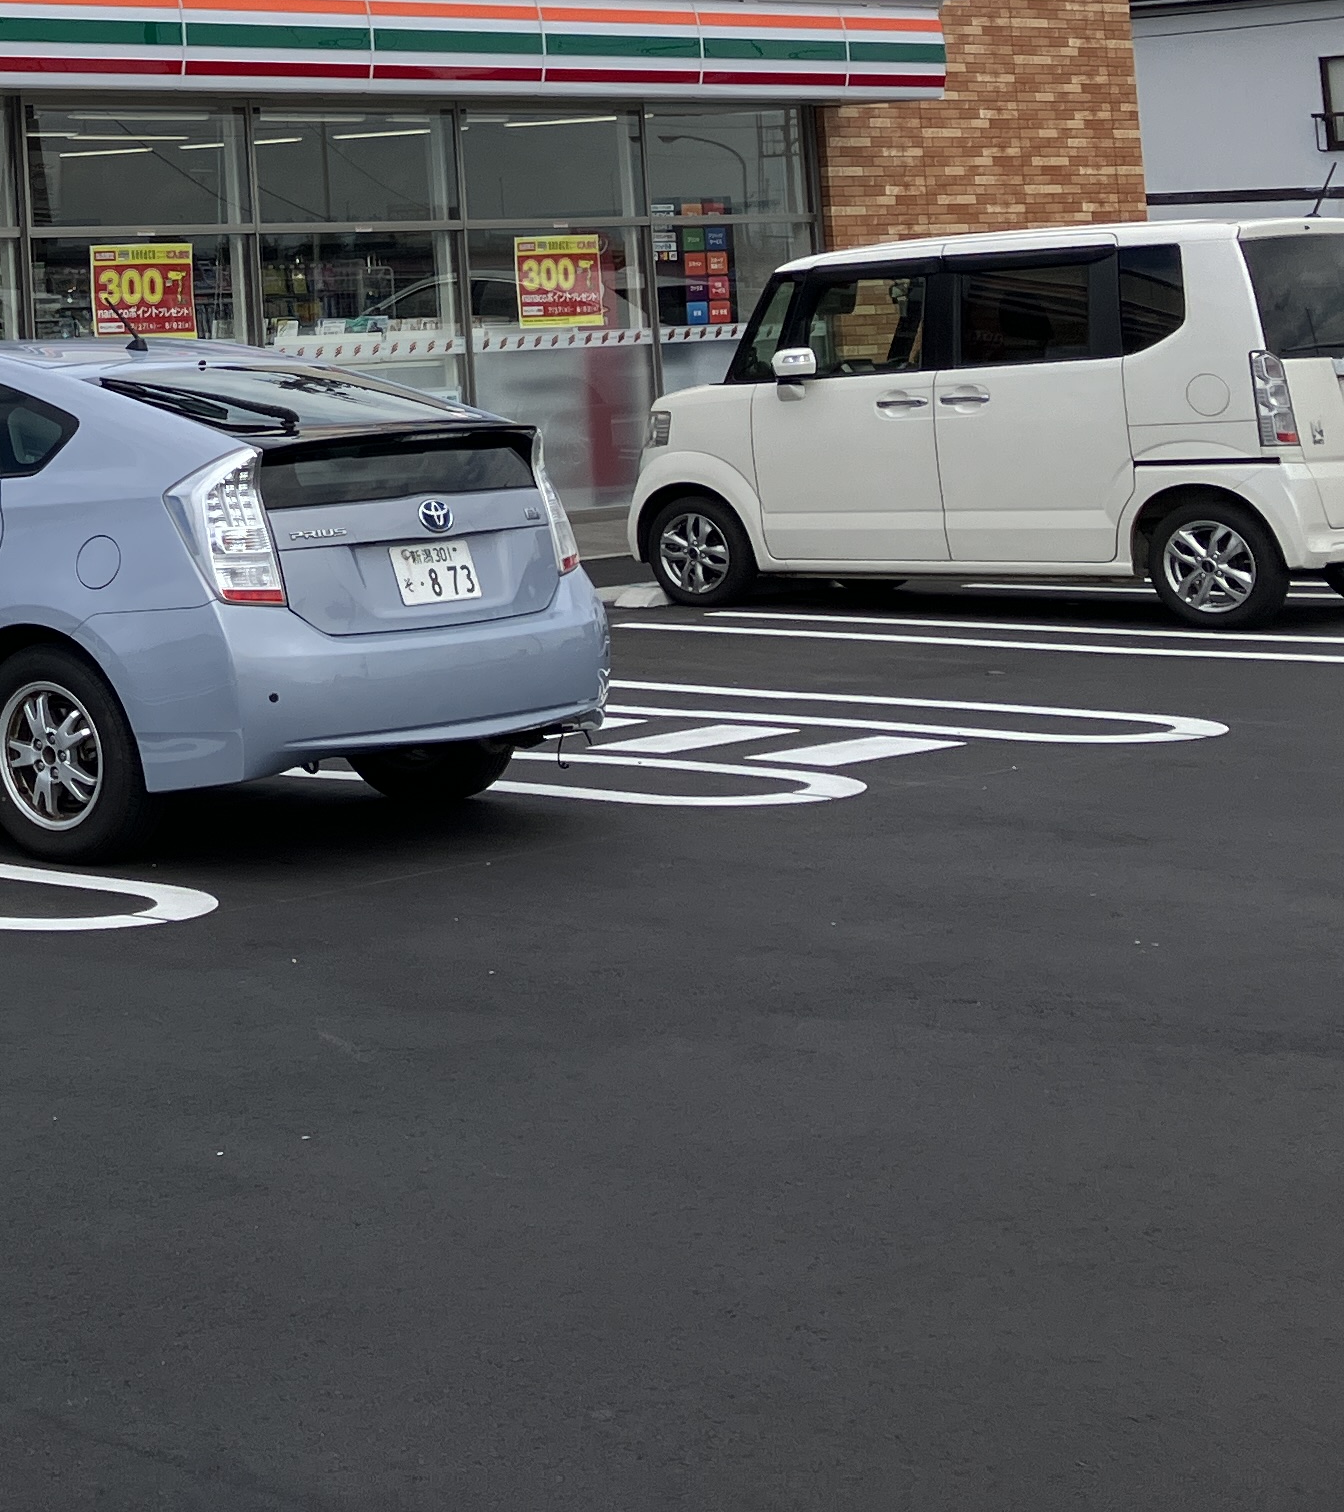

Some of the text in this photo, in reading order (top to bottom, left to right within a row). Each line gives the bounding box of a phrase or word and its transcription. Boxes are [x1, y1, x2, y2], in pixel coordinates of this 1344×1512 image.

[99, 268, 164, 306] 300
[522, 257, 576, 292] 300
[289, 526, 347, 542] PRIUS
